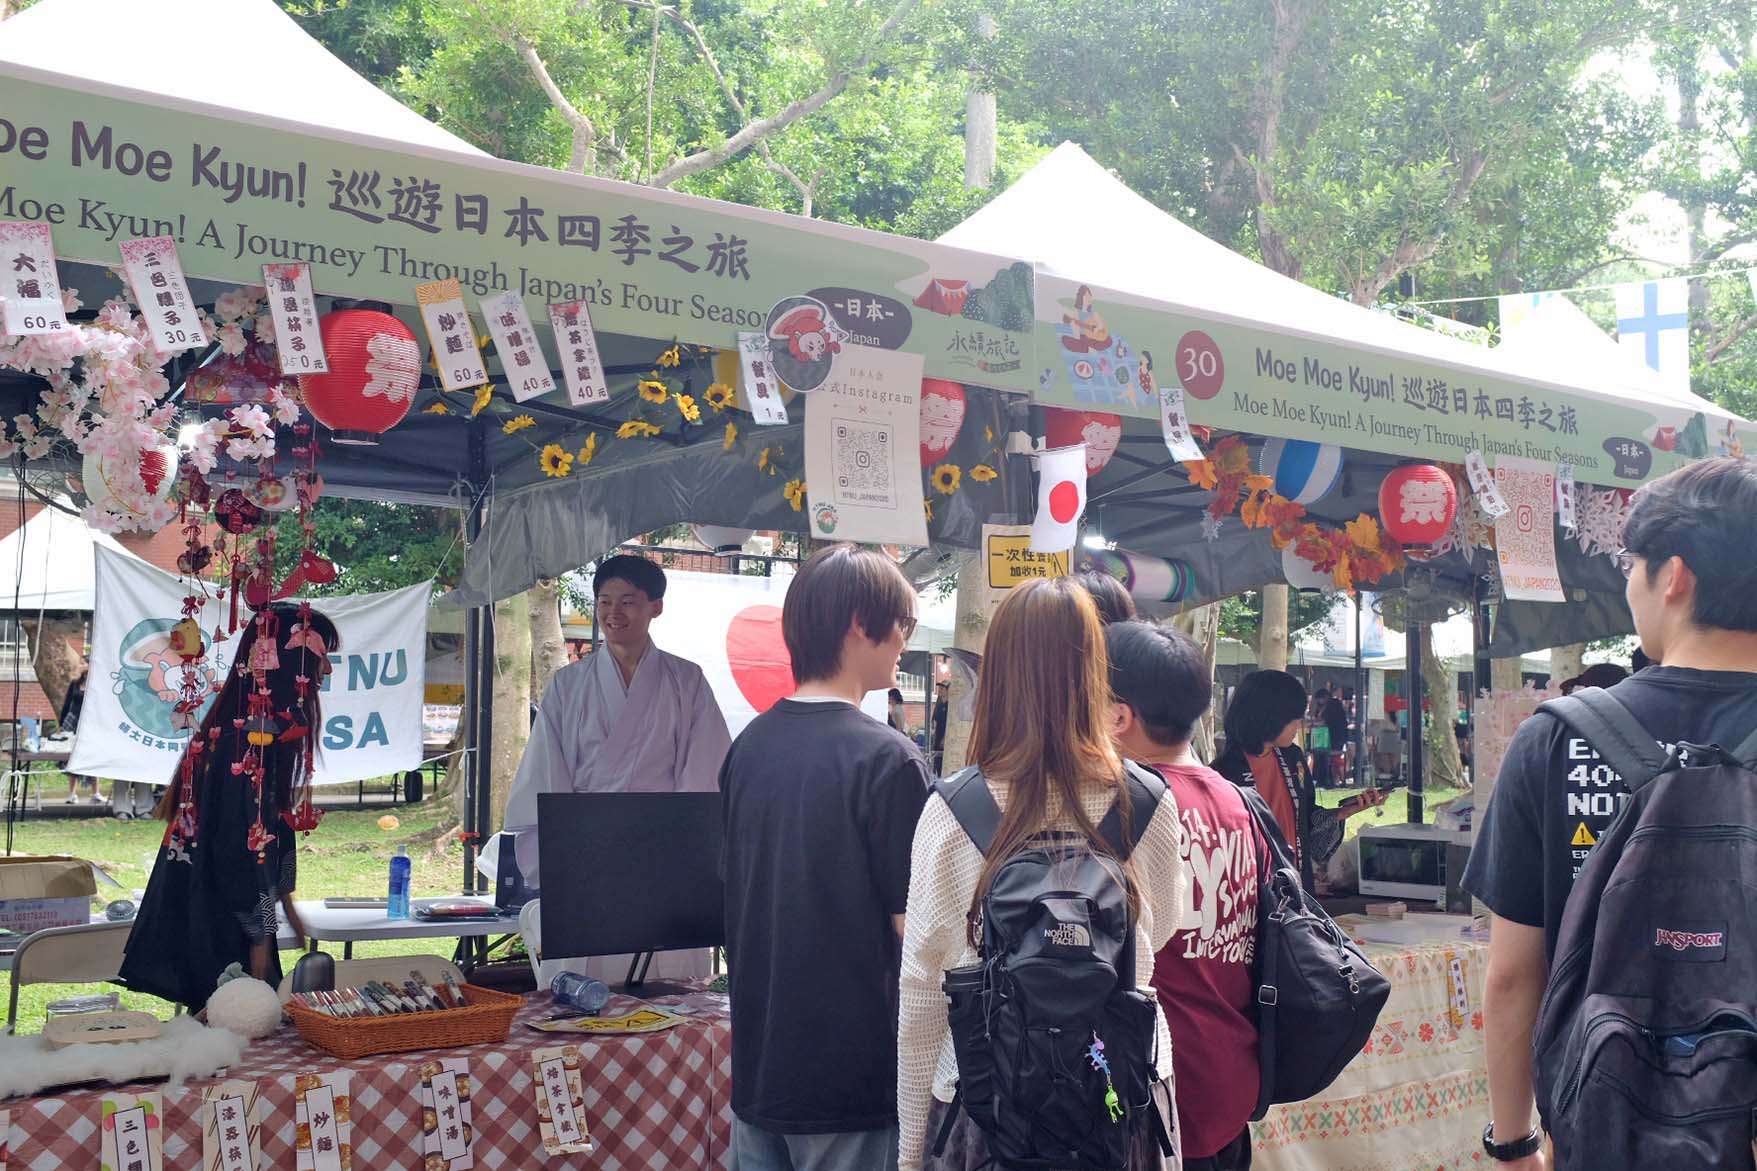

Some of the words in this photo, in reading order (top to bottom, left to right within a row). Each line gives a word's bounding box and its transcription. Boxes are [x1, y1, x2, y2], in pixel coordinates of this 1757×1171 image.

[71, 121, 173, 182] Moe
[192, 143, 307, 208] Kyun!
[326, 168, 751, 281] 巡遊日本四季之旅
[13, 252, 42, 299] 大福
[78, 198, 186, 243] Kyun!
[196, 218, 225, 249] A
[235, 223, 365, 278] Journey
[374, 246, 508, 297] Through
[518, 267, 613, 307] Japan's
[621, 284, 683, 319] Four
[690, 294, 768, 329] Seaso
[438, 312, 465, 355] 炒麵
[1182, 347, 1217, 382] 30
[1256, 347, 1296, 383] Moe
[1303, 357, 1343, 391] Moe
[1349, 365, 1395, 402] Kyun!
[1402, 375, 1579, 436] 巡遊日本四季之旅
[1233, 391, 1268, 416] Moe
[1272, 398, 1305, 419] Moe
[1310, 402, 1351, 429] Kyun!
[1354, 415, 1366, 432] A
[1368, 417, 1422, 443] Journey
[1424, 424, 1479, 454] Through
[1482, 433, 1523, 458] Japan's
[1525, 444, 1552, 461] Four
[1554, 447, 1599, 468] Seasons
[1010, 565, 1047, 577] 加收1元
[1043, 929, 1074, 938] NORTH
[1052, 937, 1074, 946] FACE
[1057, 923, 1075, 931] THE
[1655, 928, 1723, 950] JANSPORT
[313, 1112, 334, 1153] 炒麵
[437, 1084, 460, 1142] 味噌湯
